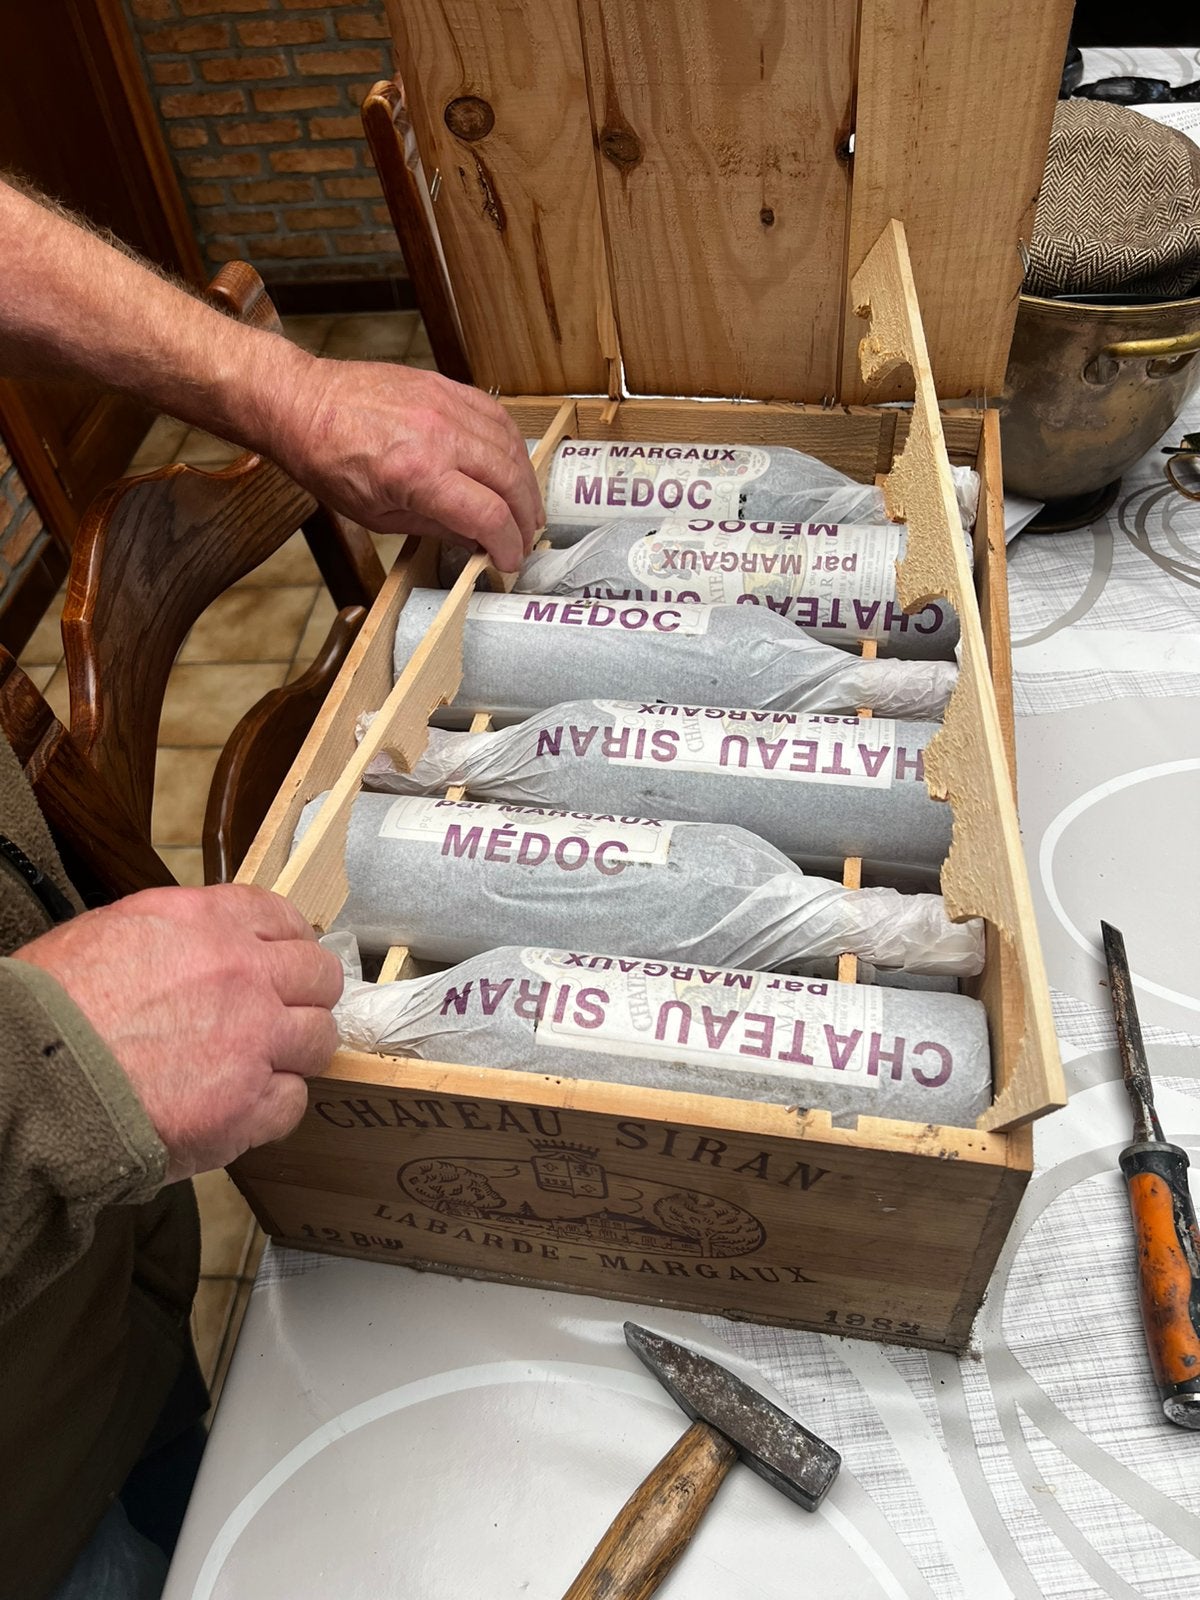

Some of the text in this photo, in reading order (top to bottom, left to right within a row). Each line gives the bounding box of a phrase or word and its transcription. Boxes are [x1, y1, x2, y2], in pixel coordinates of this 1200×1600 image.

[561, 446, 736, 461] par MARGAUX
[574, 470, 713, 510] MÉDOC
[688, 518, 839, 540] MÉDOC
[662, 548, 802, 575] MARGAUX
[812, 553, 858, 573] par
[637, 703, 798, 725] MARGAUX
[536, 725, 925, 782] HATEAU SIRAN
[440, 823, 630, 876] MÉDOC
[564, 952, 829, 997] par MARGAUX
[439, 976, 611, 1029] SIRAN
[654, 1000, 954, 1088] CHATEAU
[314, 1097, 831, 1192] CHATEAU SIRAN
